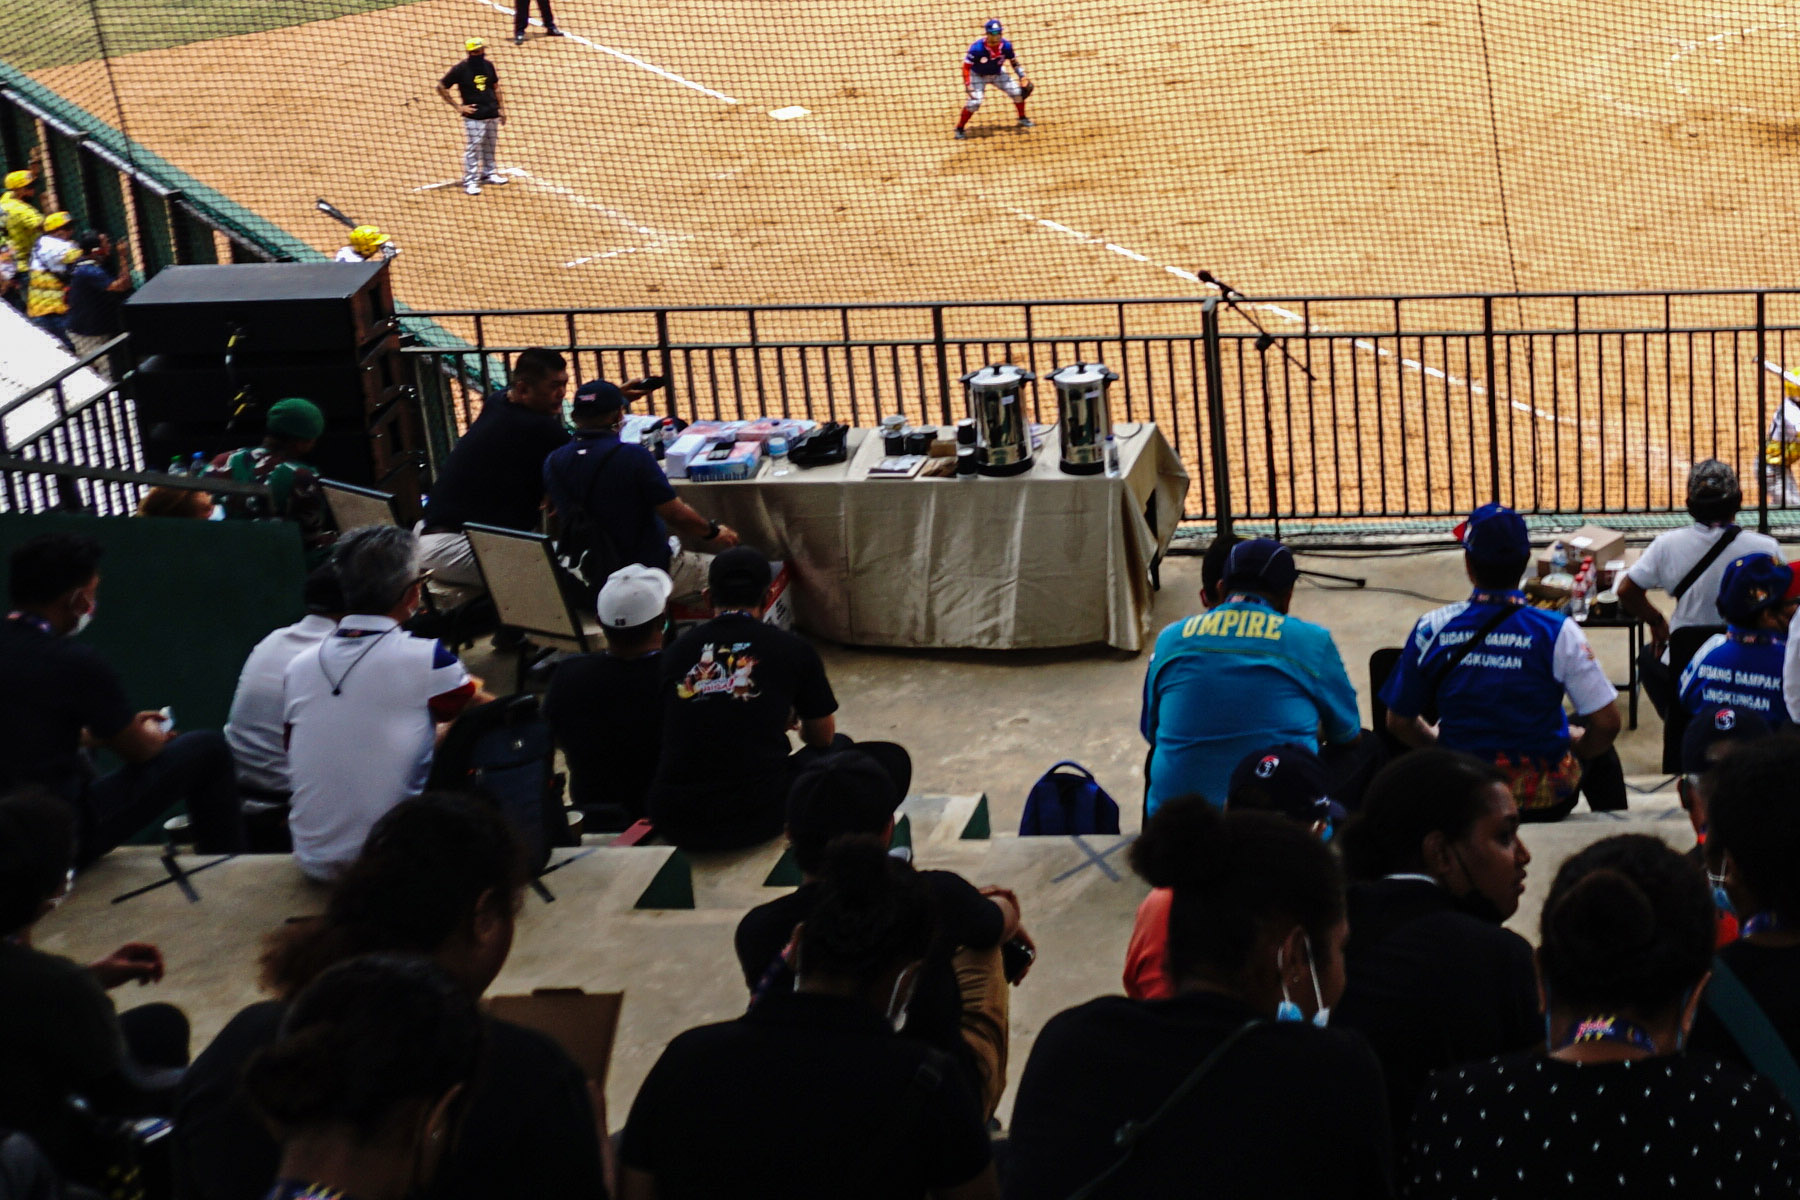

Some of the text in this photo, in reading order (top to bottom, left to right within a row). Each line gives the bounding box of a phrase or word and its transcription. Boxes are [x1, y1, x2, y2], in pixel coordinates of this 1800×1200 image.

[1182, 609, 1285, 640] UMPIRE
[1439, 630, 1478, 647] BIDAN
[1698, 663, 1781, 691] BIDANG DAMPAK
